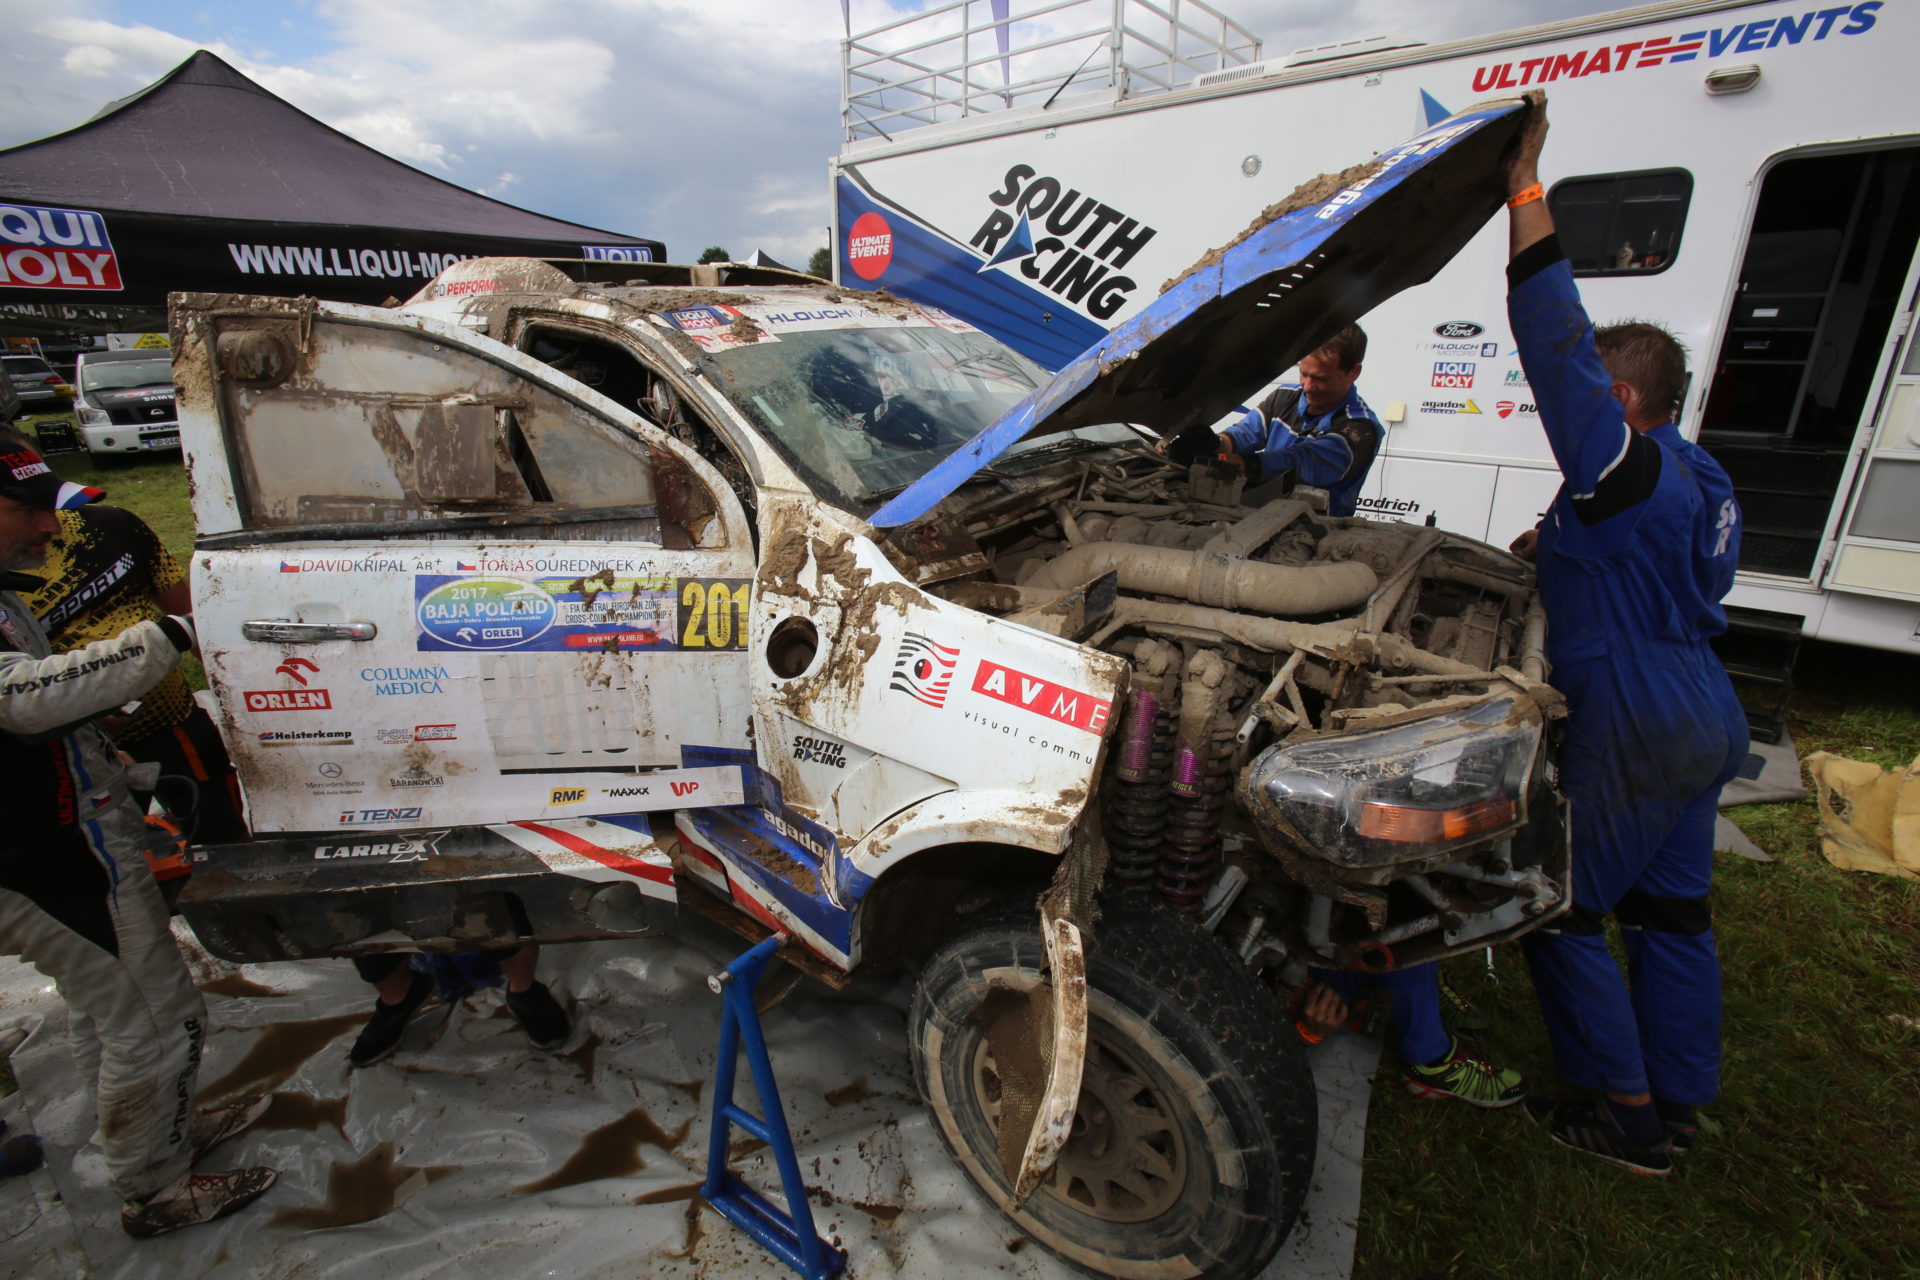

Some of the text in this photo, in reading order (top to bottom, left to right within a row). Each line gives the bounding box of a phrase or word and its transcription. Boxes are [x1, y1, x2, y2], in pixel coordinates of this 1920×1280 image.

[988, 164, 1157, 270] SOUTH
[851, 234, 891, 247] ULTIMATE
[850, 244, 890, 259] EVENTS
[675, 311, 711, 321] LIQUI
[681, 319, 717, 330] MOLY
[1443, 323, 1475, 337] Ford
[1432, 343, 1480, 351] HLOUCH
[1435, 363, 1474, 376] LIQUI
[1432, 375, 1474, 388] MOLY
[1421, 400, 1466, 410] agados
[451, 587, 489, 601] 2017
[425, 600, 548, 619] BAJA POLAND
[484, 628, 521, 639] ORLEN
[361, 666, 450, 682] COLUMNA
[375, 682, 445, 696] MEDICA
[249, 692, 328, 710] ORLEN
[964, 710, 1019, 738] visual
[275, 730, 352, 741] Heisterkamp
[792, 736, 845, 756] SOUTH
[390, 776, 444, 788] BARANOWSKI
[552, 789, 585, 803] RMF
[609, 787, 650, 798] MAXXX
[360, 807, 423, 821] TENZI
